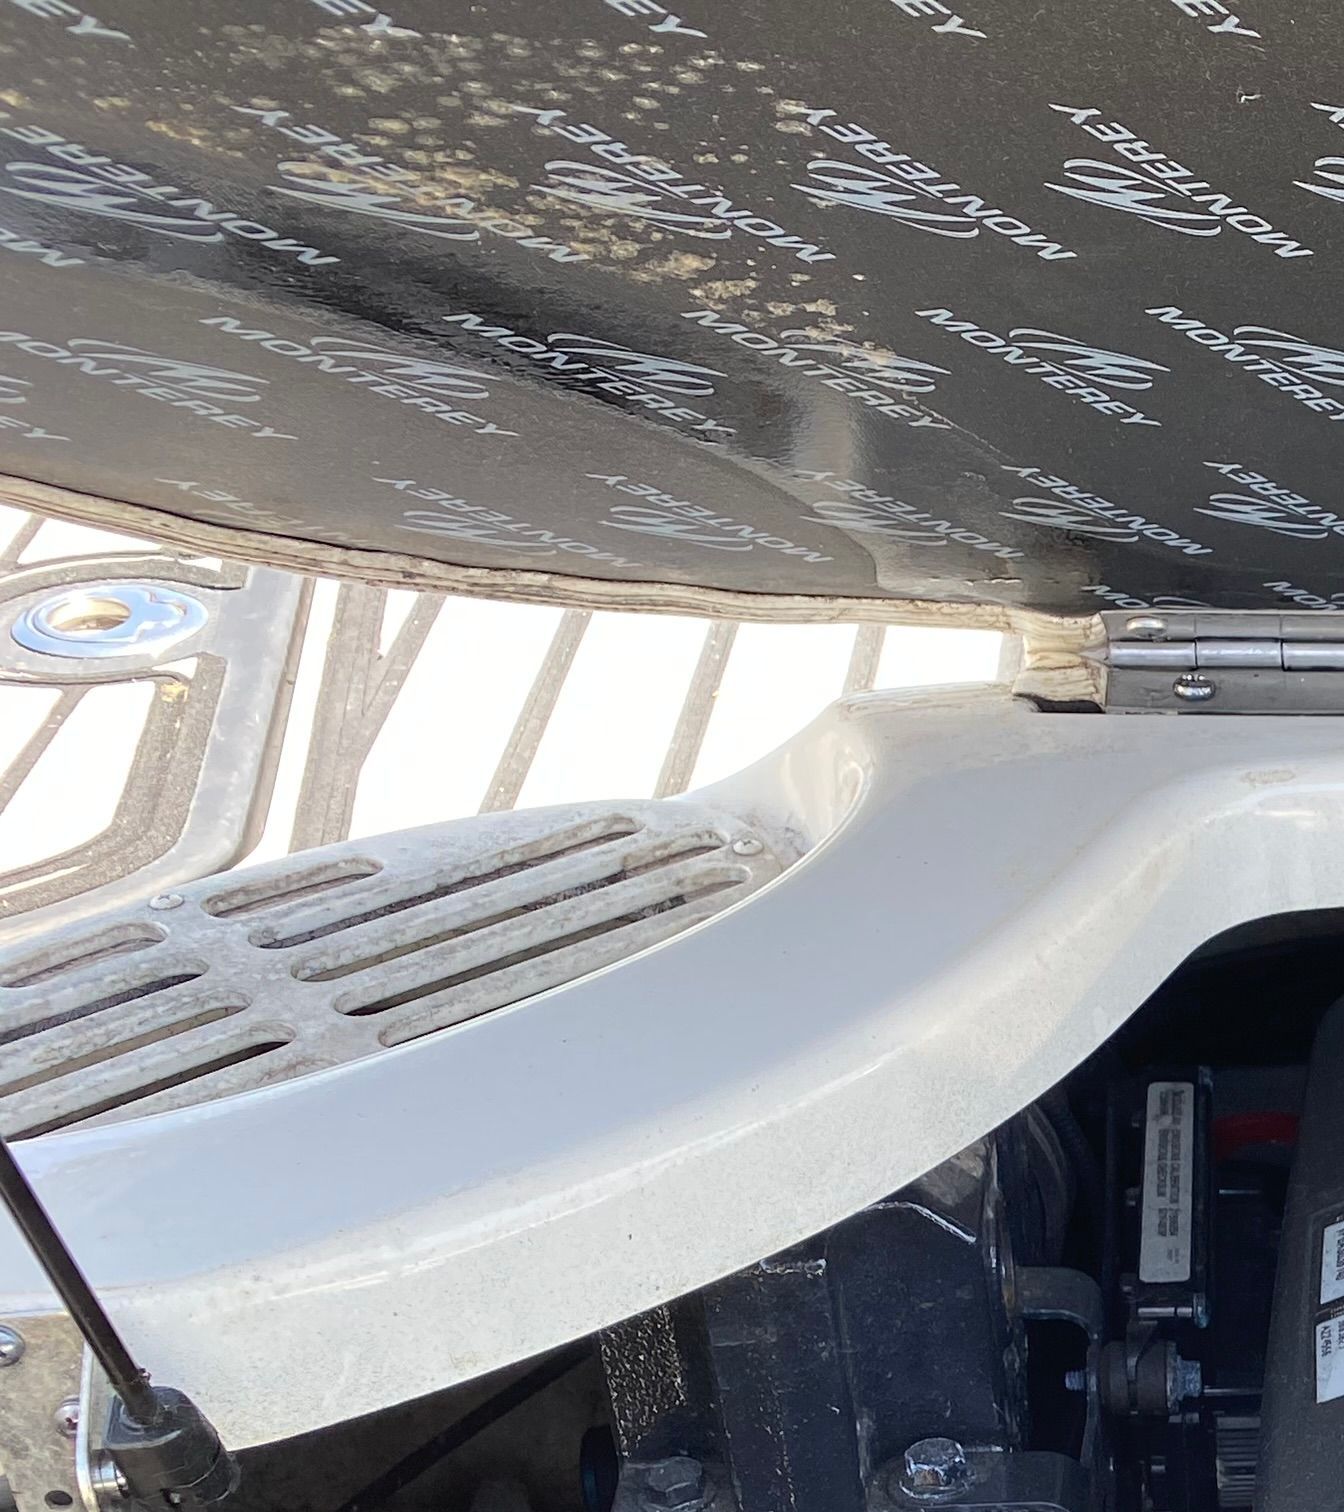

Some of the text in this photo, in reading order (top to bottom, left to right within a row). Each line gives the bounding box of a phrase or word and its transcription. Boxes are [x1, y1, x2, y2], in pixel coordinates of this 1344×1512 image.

[0, 110, 340, 266] MONTERE
[231, 105, 587, 264] MONTEREY
[513, 105, 836, 264] MONTEREY
[801, 105, 1077, 262] MONTEREY
[1049, 103, 1314, 259] MONTEREY
[200, 316, 521, 436] MONTEREY
[443, 313, 736, 434] MONTEREY
[682, 309, 950, 429] MONTEREY
[915, 306, 1161, 427] MONTEREY
[373, 478, 644, 569] MONTEREY
[587, 473, 834, 565] MONTEREY
[795, 469, 1025, 560] MONTEREY
[1000, 464, 1214, 555] MONTEREY
